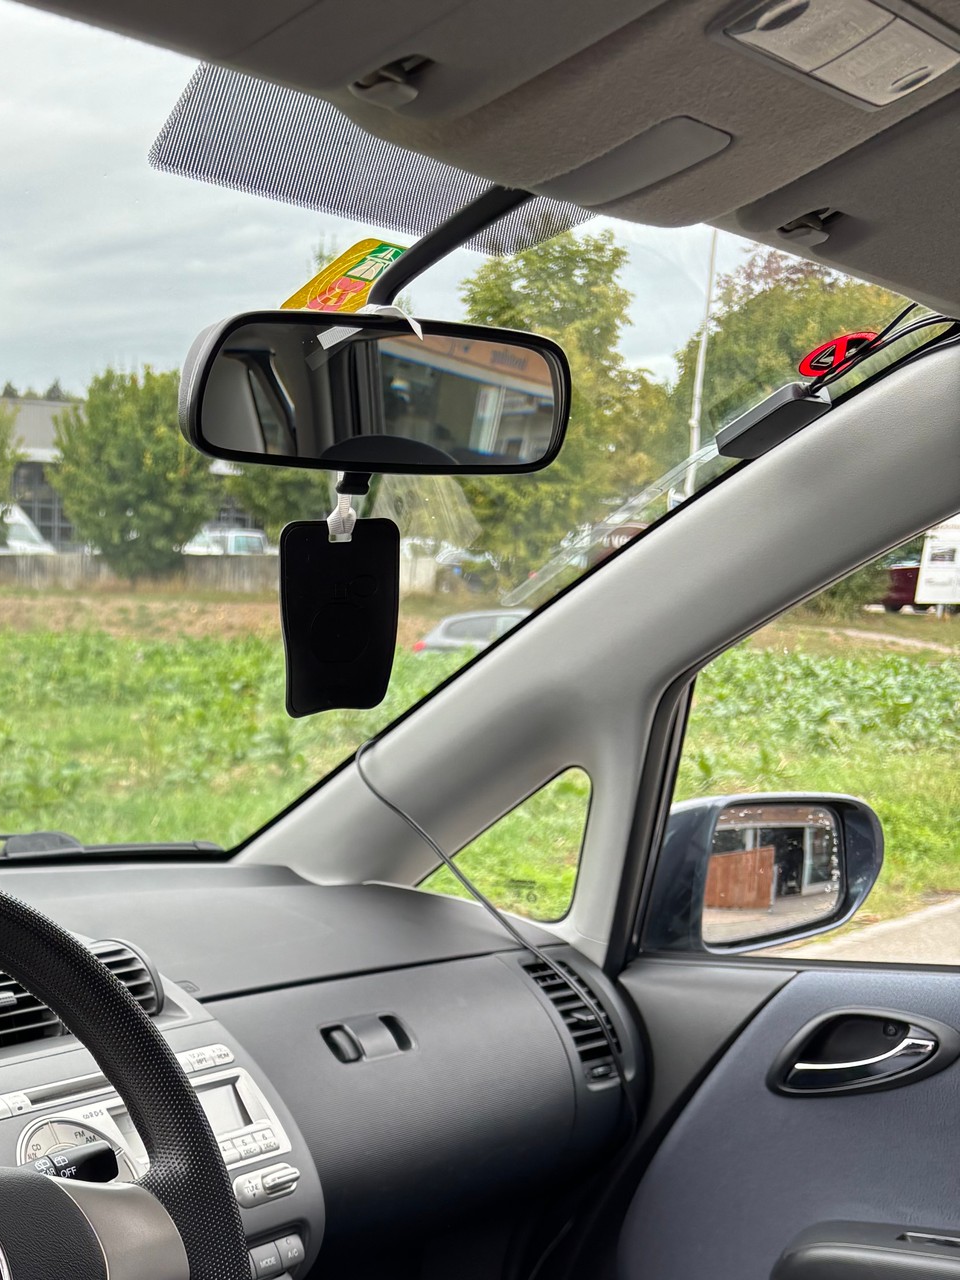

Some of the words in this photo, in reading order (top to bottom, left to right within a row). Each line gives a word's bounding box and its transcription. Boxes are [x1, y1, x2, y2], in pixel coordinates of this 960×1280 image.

[74, 1130, 86, 1139] FM
[85, 1135, 97, 1144] AM
[32, 1143, 42, 1152] CD
[60, 1166, 77, 1178] OFF
[244, 1183, 260, 1194] TUNE
[259, 1256, 277, 1269] MODE
